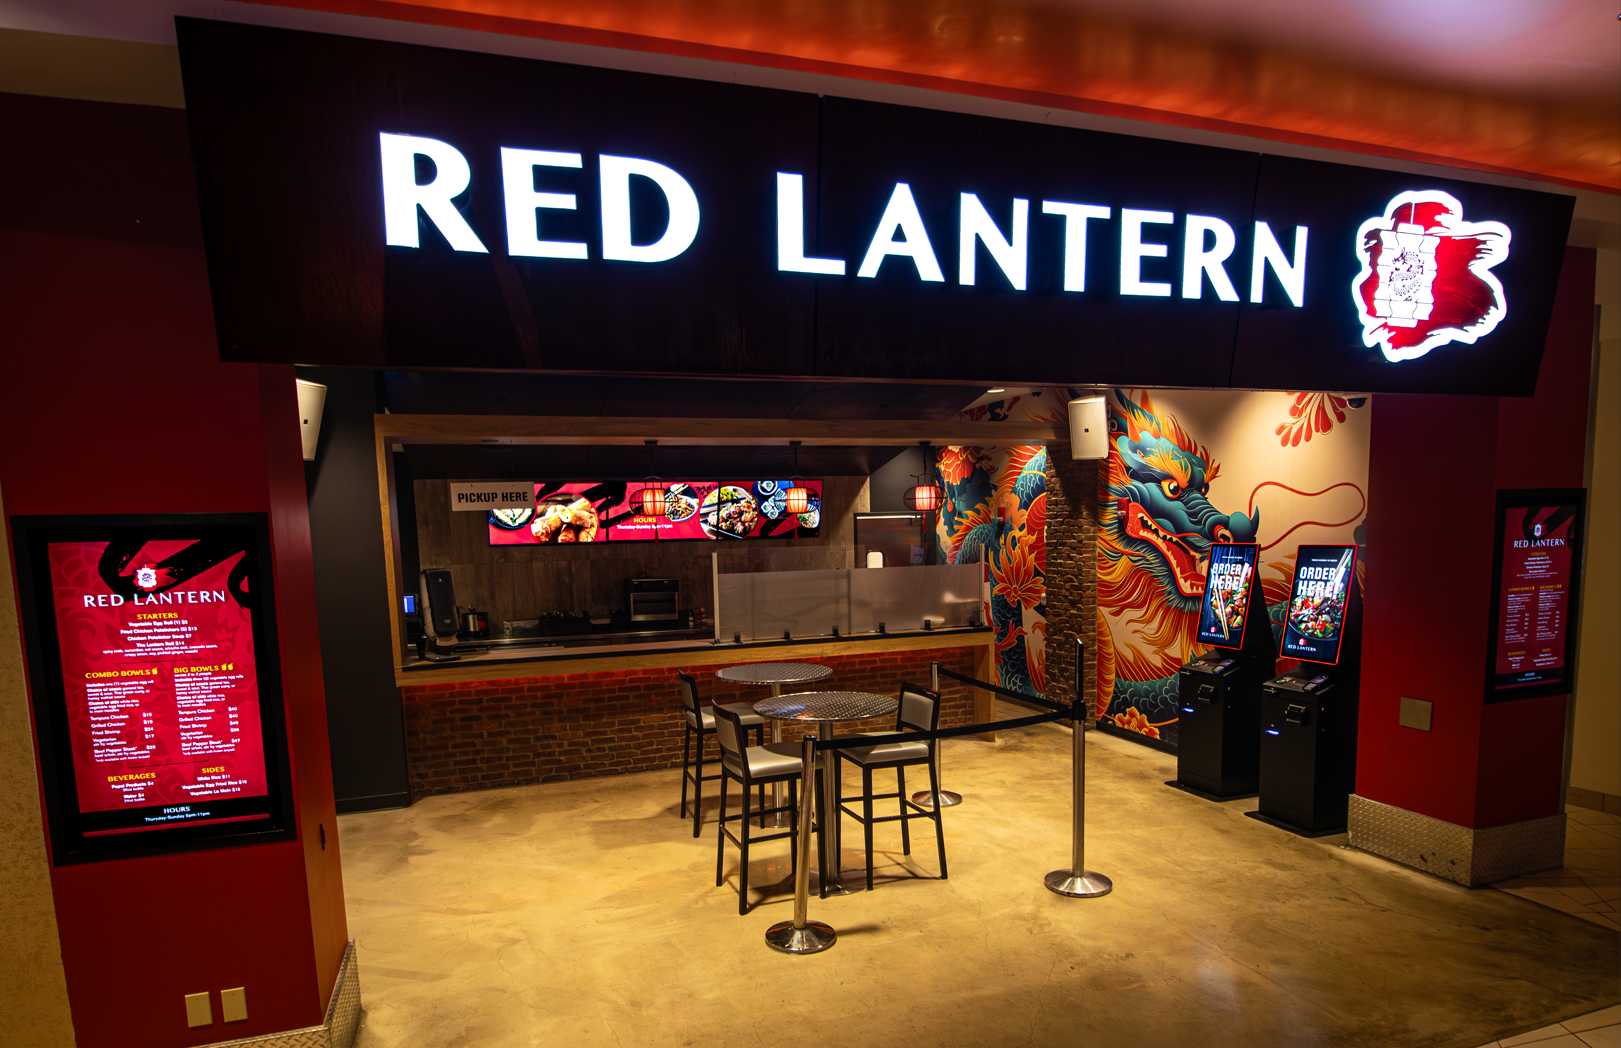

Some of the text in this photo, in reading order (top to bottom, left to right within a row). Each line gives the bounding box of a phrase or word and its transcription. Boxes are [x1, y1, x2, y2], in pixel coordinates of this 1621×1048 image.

[380, 131, 1309, 308] RED LANTERN
[458, 492, 528, 503] PICKUP HERE
[1514, 539, 1564, 548] RED LANTERN
[1212, 563, 1242, 576] ORDER
[1300, 566, 1338, 580] ORDER
[83, 590, 226, 608] RED LANTERN
[137, 612, 178, 620] STARTERS
[202, 766, 225, 774] SIDES
[108, 773, 156, 782] BEVERAGES
[163, 806, 190, 814] HOURS
